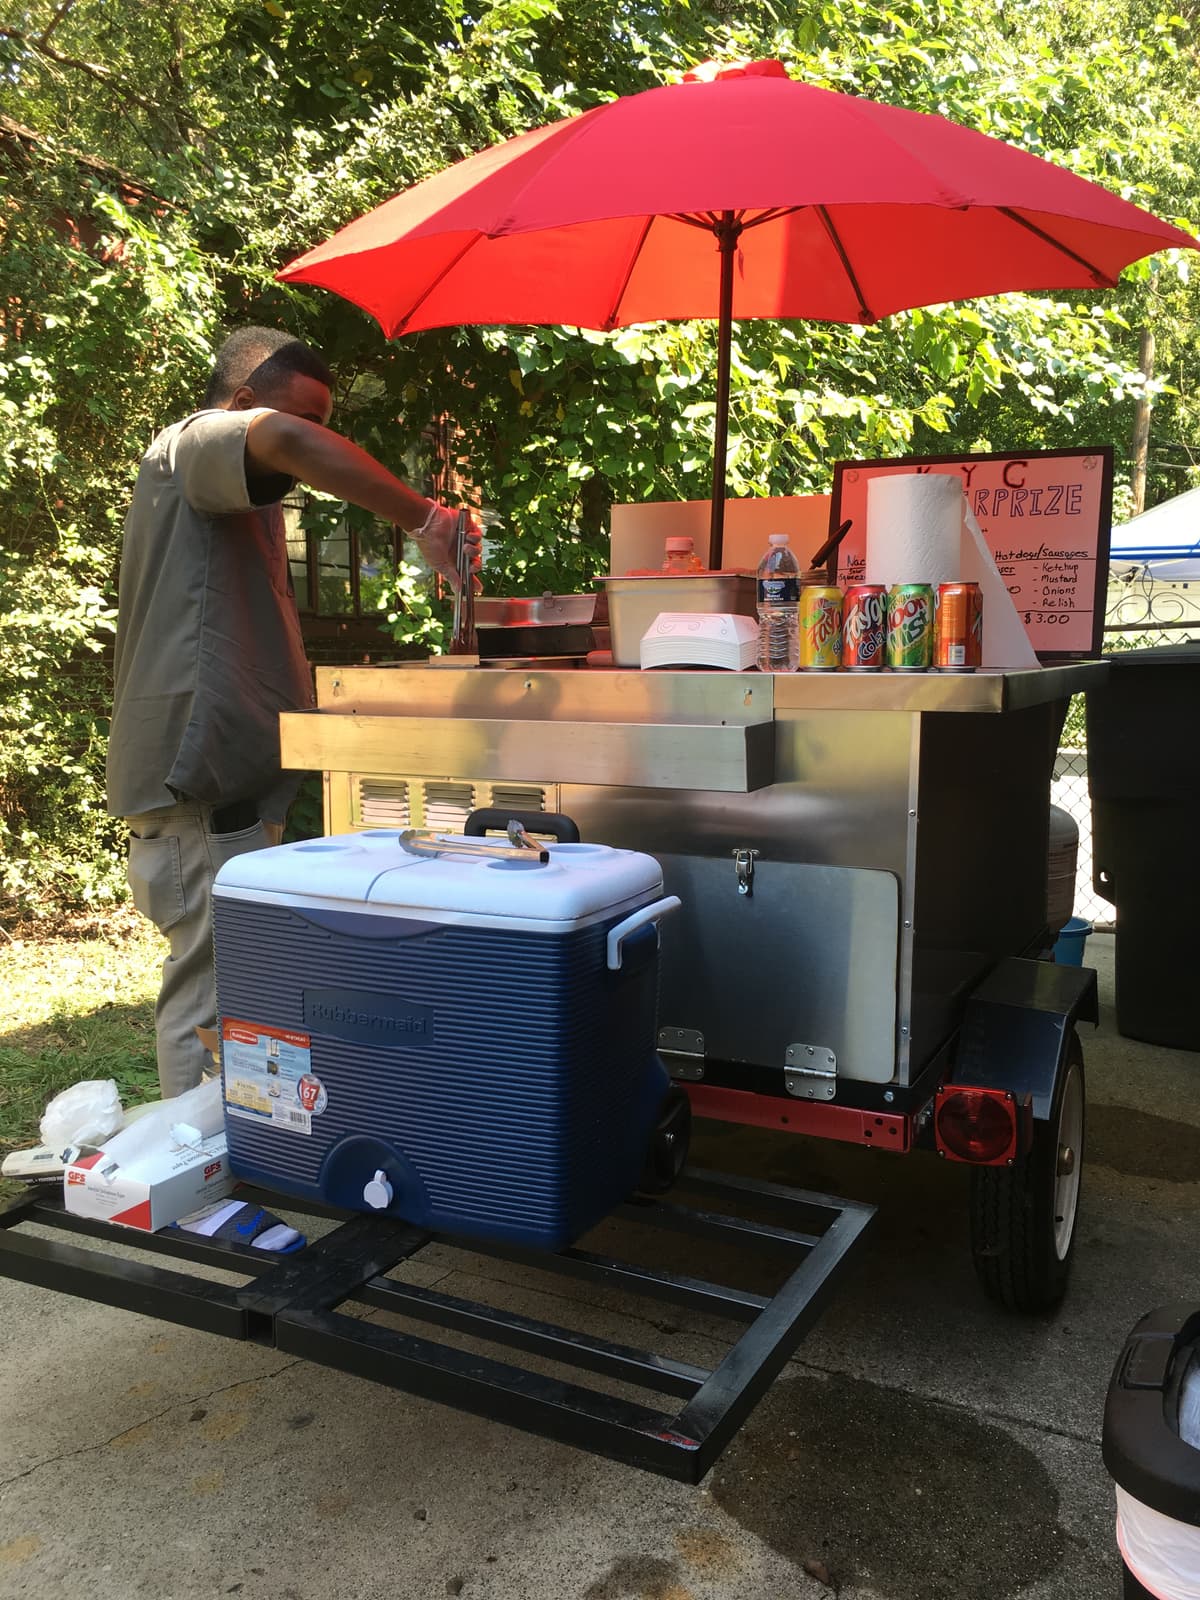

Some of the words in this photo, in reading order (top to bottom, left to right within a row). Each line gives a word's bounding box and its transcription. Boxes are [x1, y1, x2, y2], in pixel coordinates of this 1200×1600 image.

[964, 484, 1083, 517] RPRIZE
[847, 554, 866, 567] Nac
[1042, 563, 1079, 573] Ketchup
[1041, 575, 1078, 583] Mustard
[1042, 586, 1076, 595] Onions
[1042, 598, 1075, 608] Relish
[858, 631, 885, 660] Cola
[311, 1003, 428, 1034] Rubbermaid
[303, 1087, 317, 1101] 67
[68, 1171, 86, 1183] GFS
